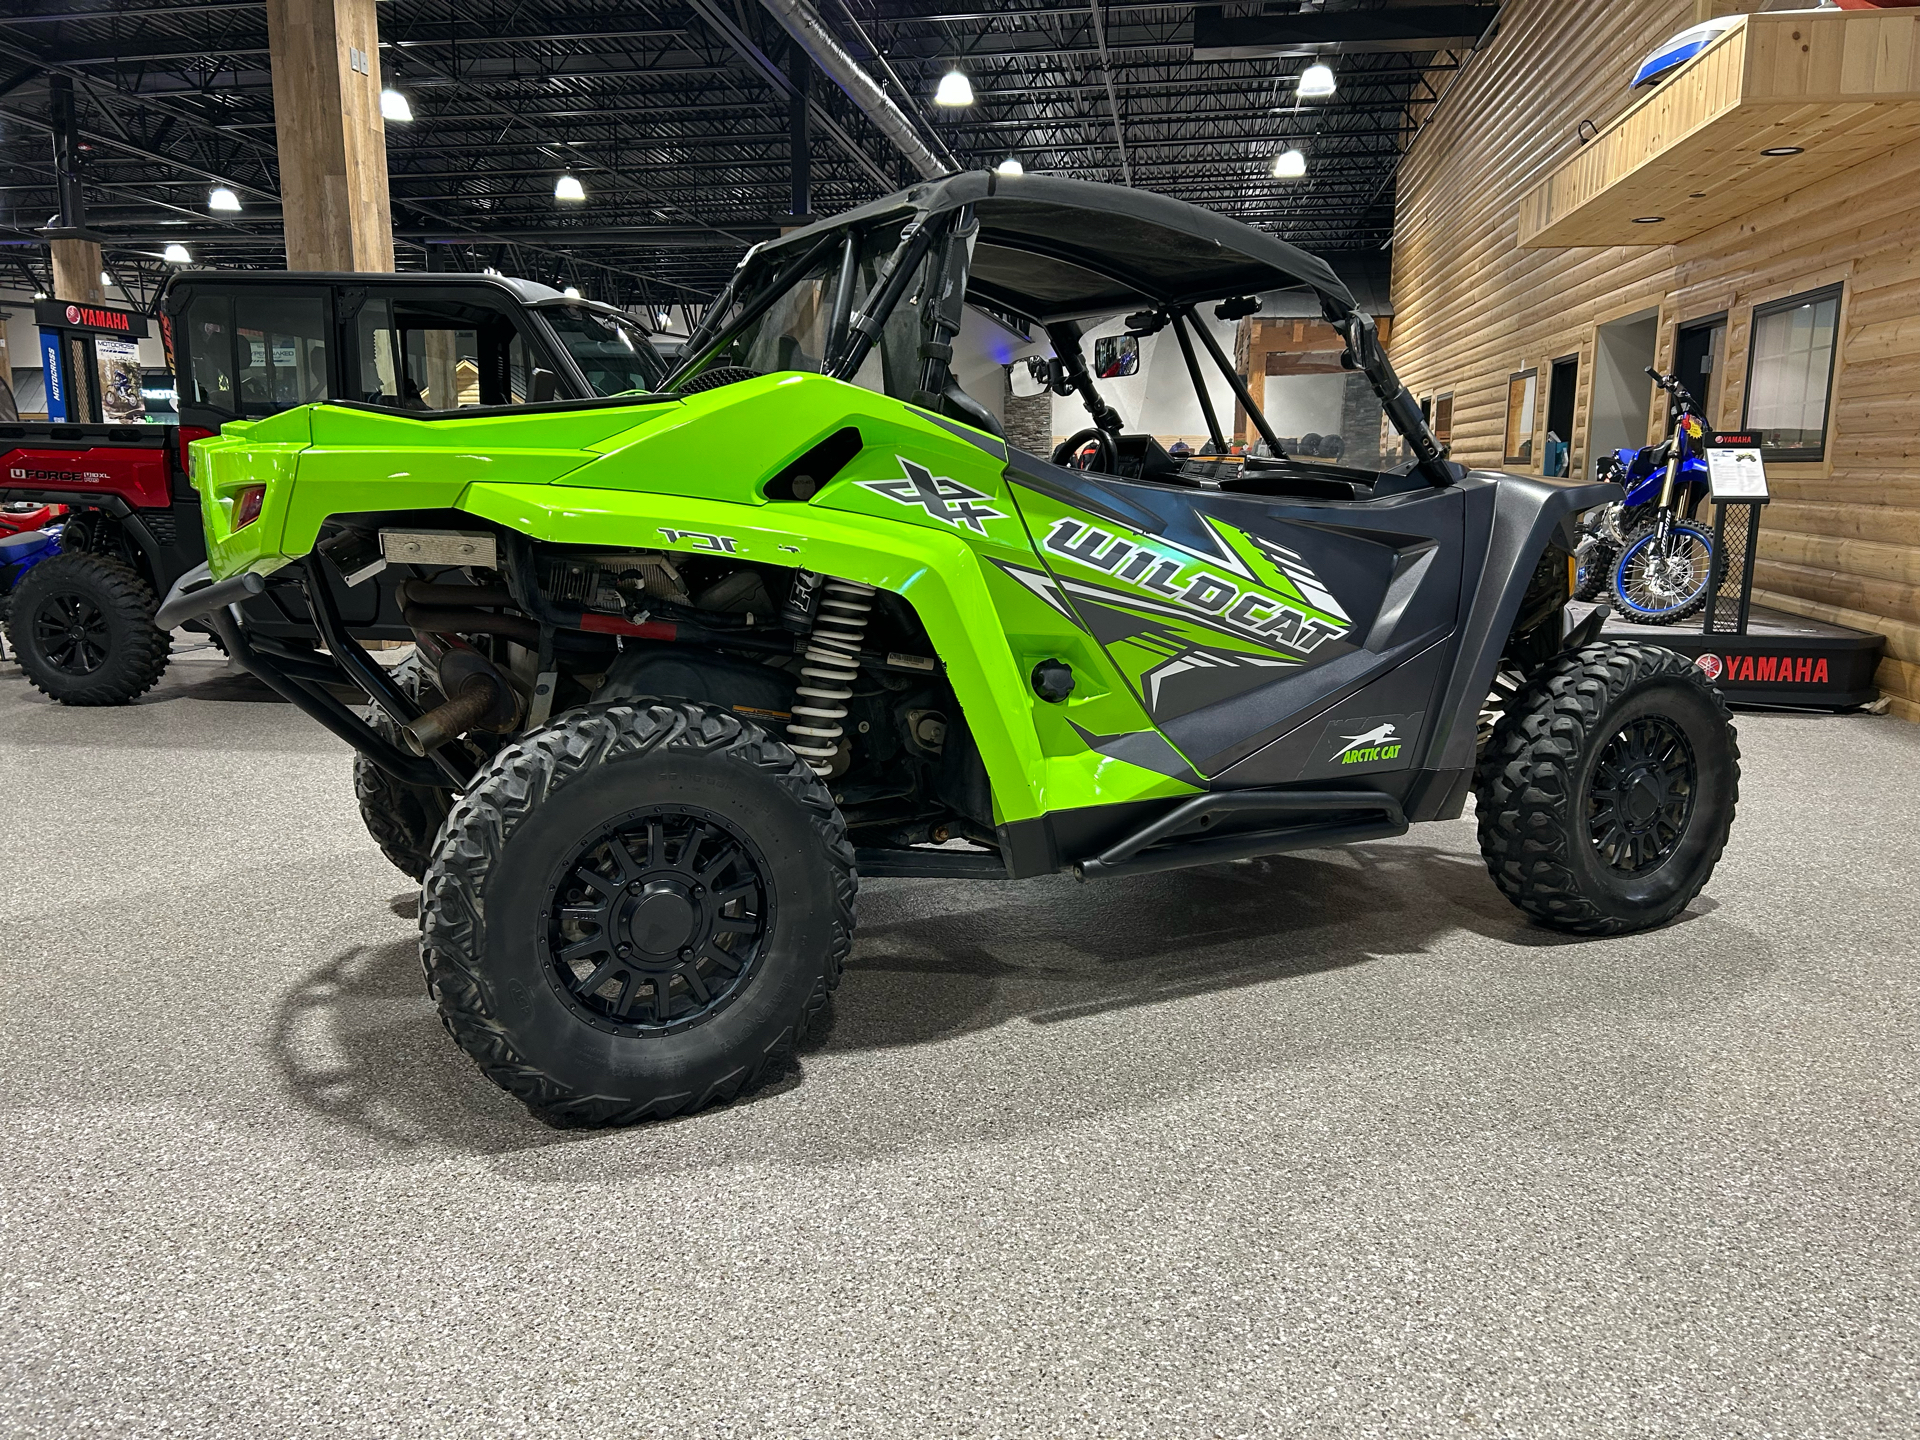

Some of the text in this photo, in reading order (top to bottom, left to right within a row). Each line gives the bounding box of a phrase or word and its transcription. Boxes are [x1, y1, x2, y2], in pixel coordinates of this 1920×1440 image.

[80, 307, 130, 331] YAMAHA
[97, 340, 135, 350] MOTOCROSS
[47, 347, 61, 401] MOTOCROSS
[1723, 436, 1752, 444] YAMAHA
[1042, 516, 1349, 654] WILDCAT
[1725, 655, 1829, 683] YAMAHA
[1341, 744, 1402, 764] ARCTIC CAT
